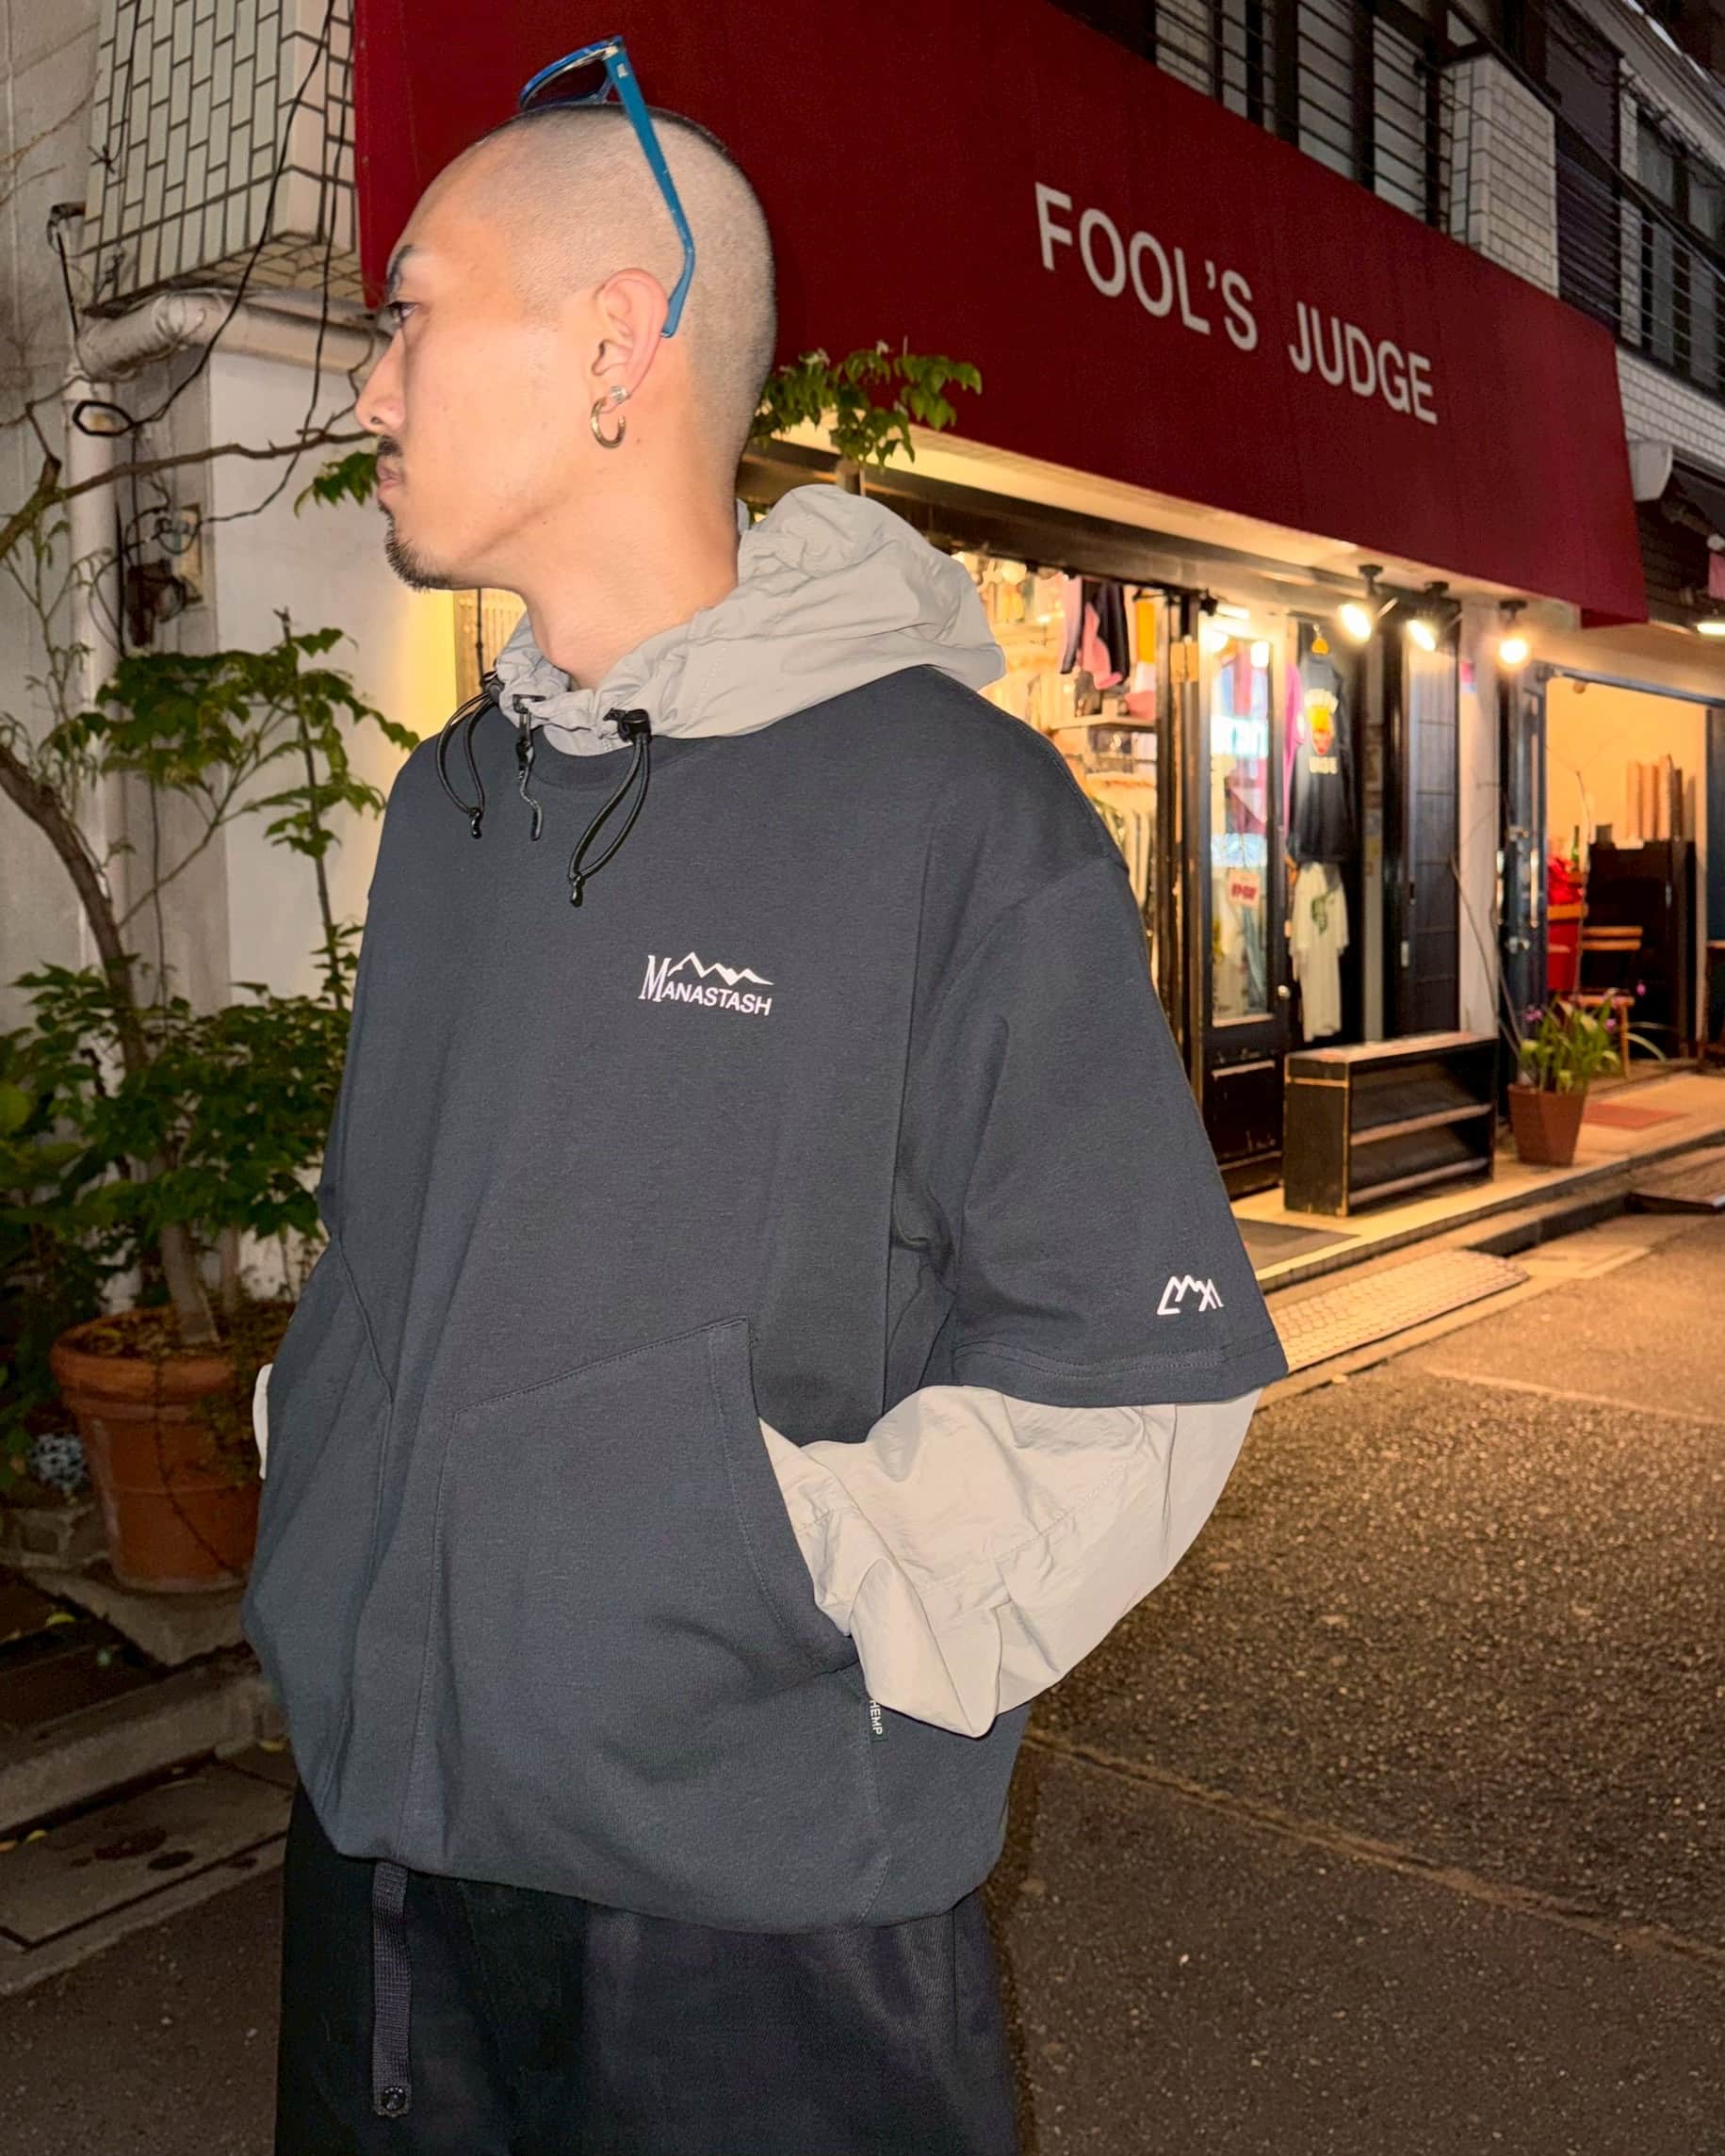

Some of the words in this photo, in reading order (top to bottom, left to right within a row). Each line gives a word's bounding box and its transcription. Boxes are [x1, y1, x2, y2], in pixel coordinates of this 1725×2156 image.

[1287, 300, 1440, 425] JUDGE
[638, 954, 773, 1016] MANASTASH
[870, 1700, 883, 1735] HEMP
